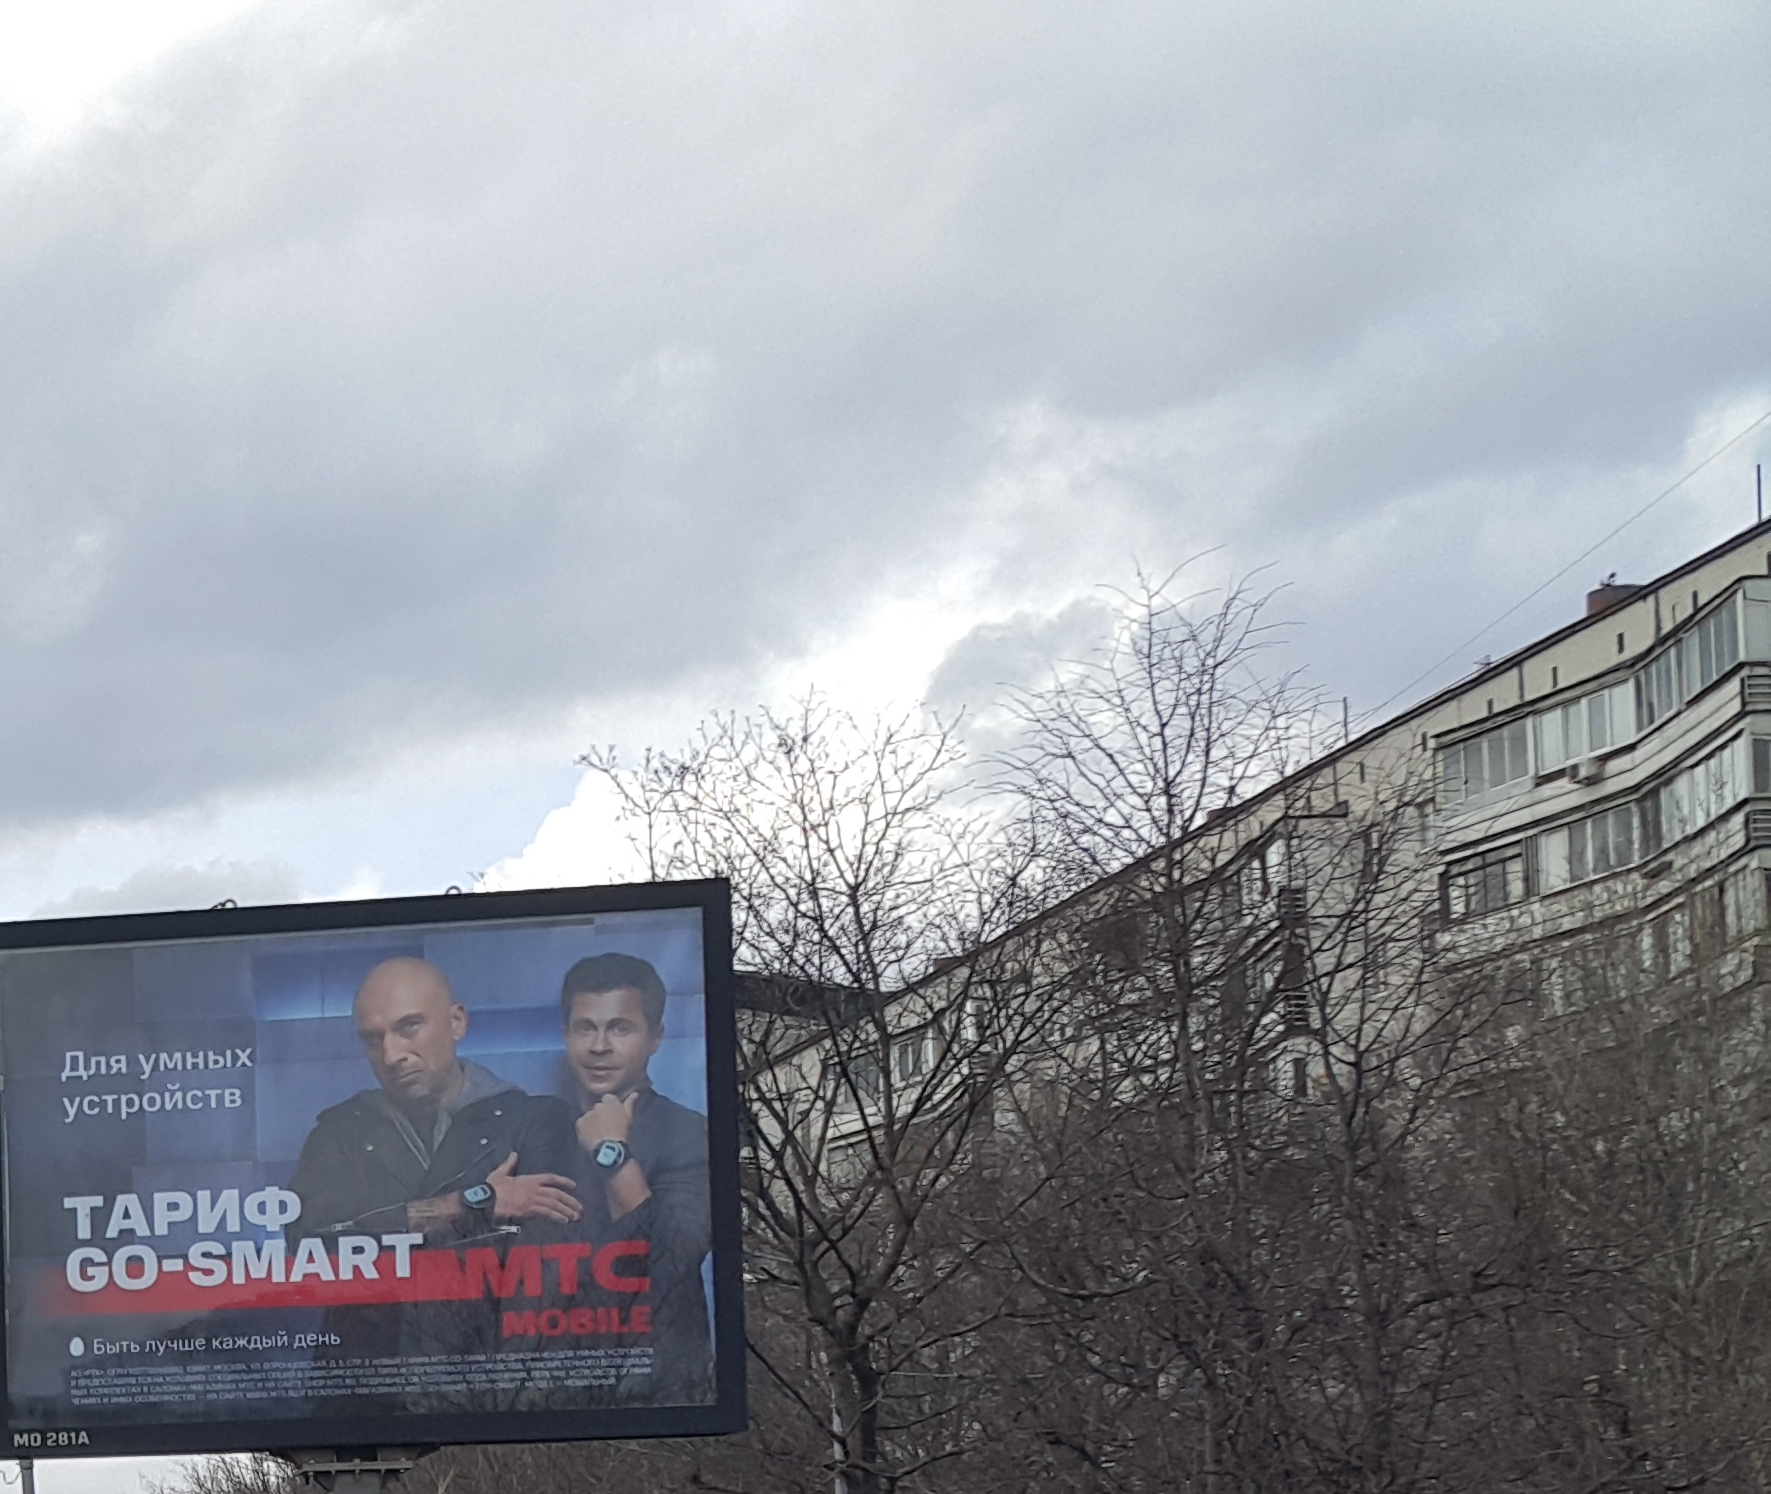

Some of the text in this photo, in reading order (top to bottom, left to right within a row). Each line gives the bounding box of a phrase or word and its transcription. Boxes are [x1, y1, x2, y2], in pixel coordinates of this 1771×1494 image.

[61, 1047, 254, 1082] Для умных
[62, 1082, 242, 1123] устройств
[63, 1186, 302, 1240] ТАРИФ
[65, 1232, 424, 1293] GO-SMART
[462, 1239, 652, 1299] МТС
[502, 1304, 652, 1339] MOBILE
[92, 1330, 341, 1356] Быть лучше каждый день
